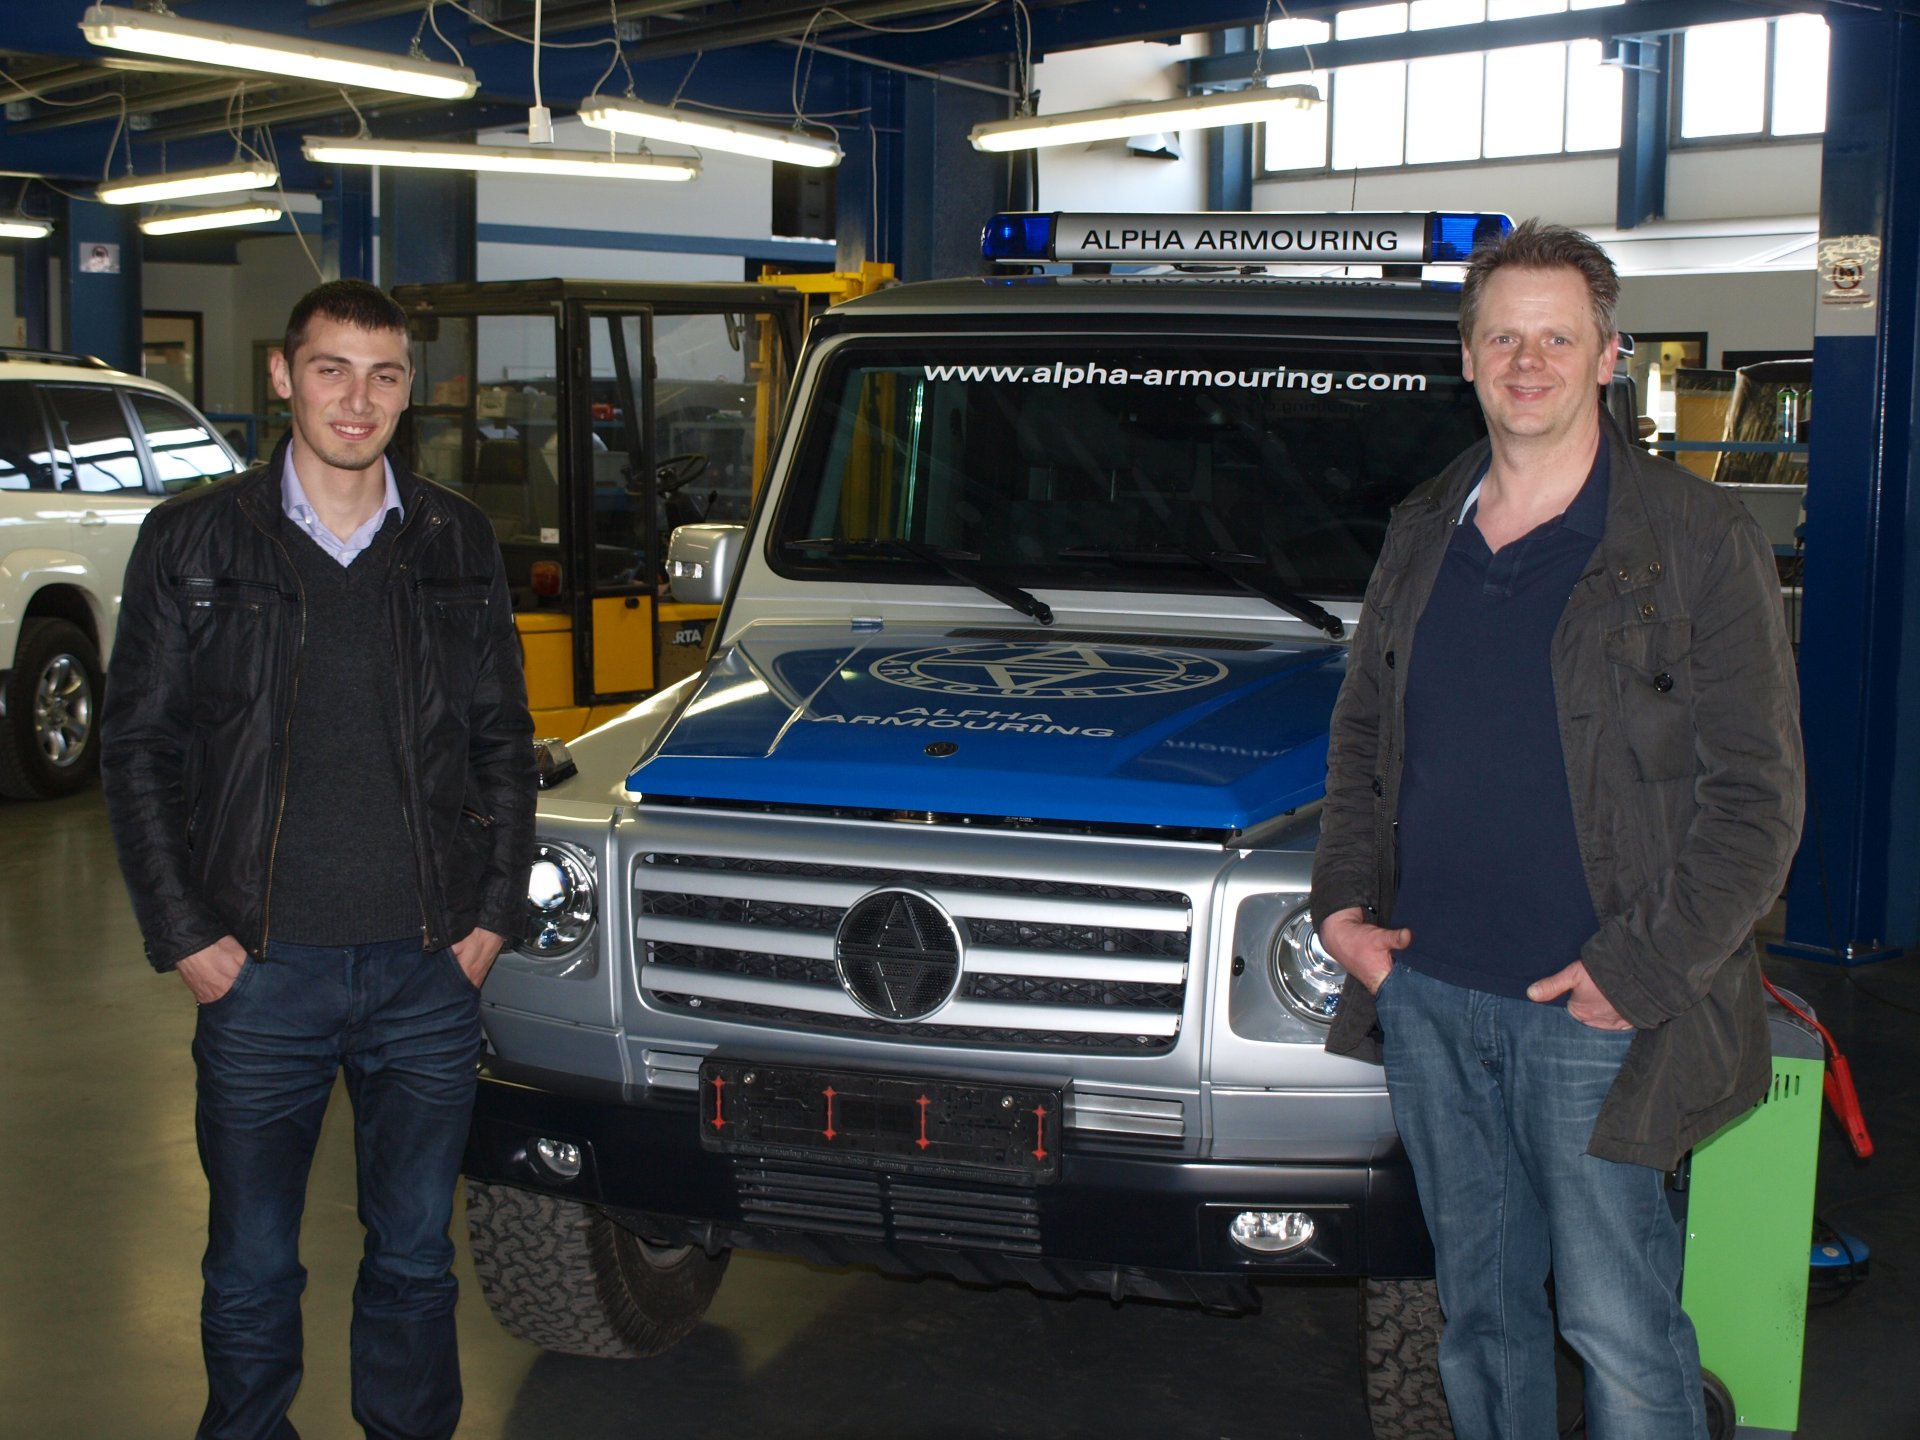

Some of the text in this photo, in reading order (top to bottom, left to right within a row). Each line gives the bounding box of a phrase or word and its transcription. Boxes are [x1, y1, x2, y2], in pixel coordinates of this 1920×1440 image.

[1081, 229, 1398, 251] ALPHA ARMOURING
[923, 361, 1427, 395] www.alpha-armouring.com
[880, 659, 1214, 697] ARMOURING
[811, 714, 1116, 738] ARMOURING
[895, 707, 1053, 723] ALPHA
